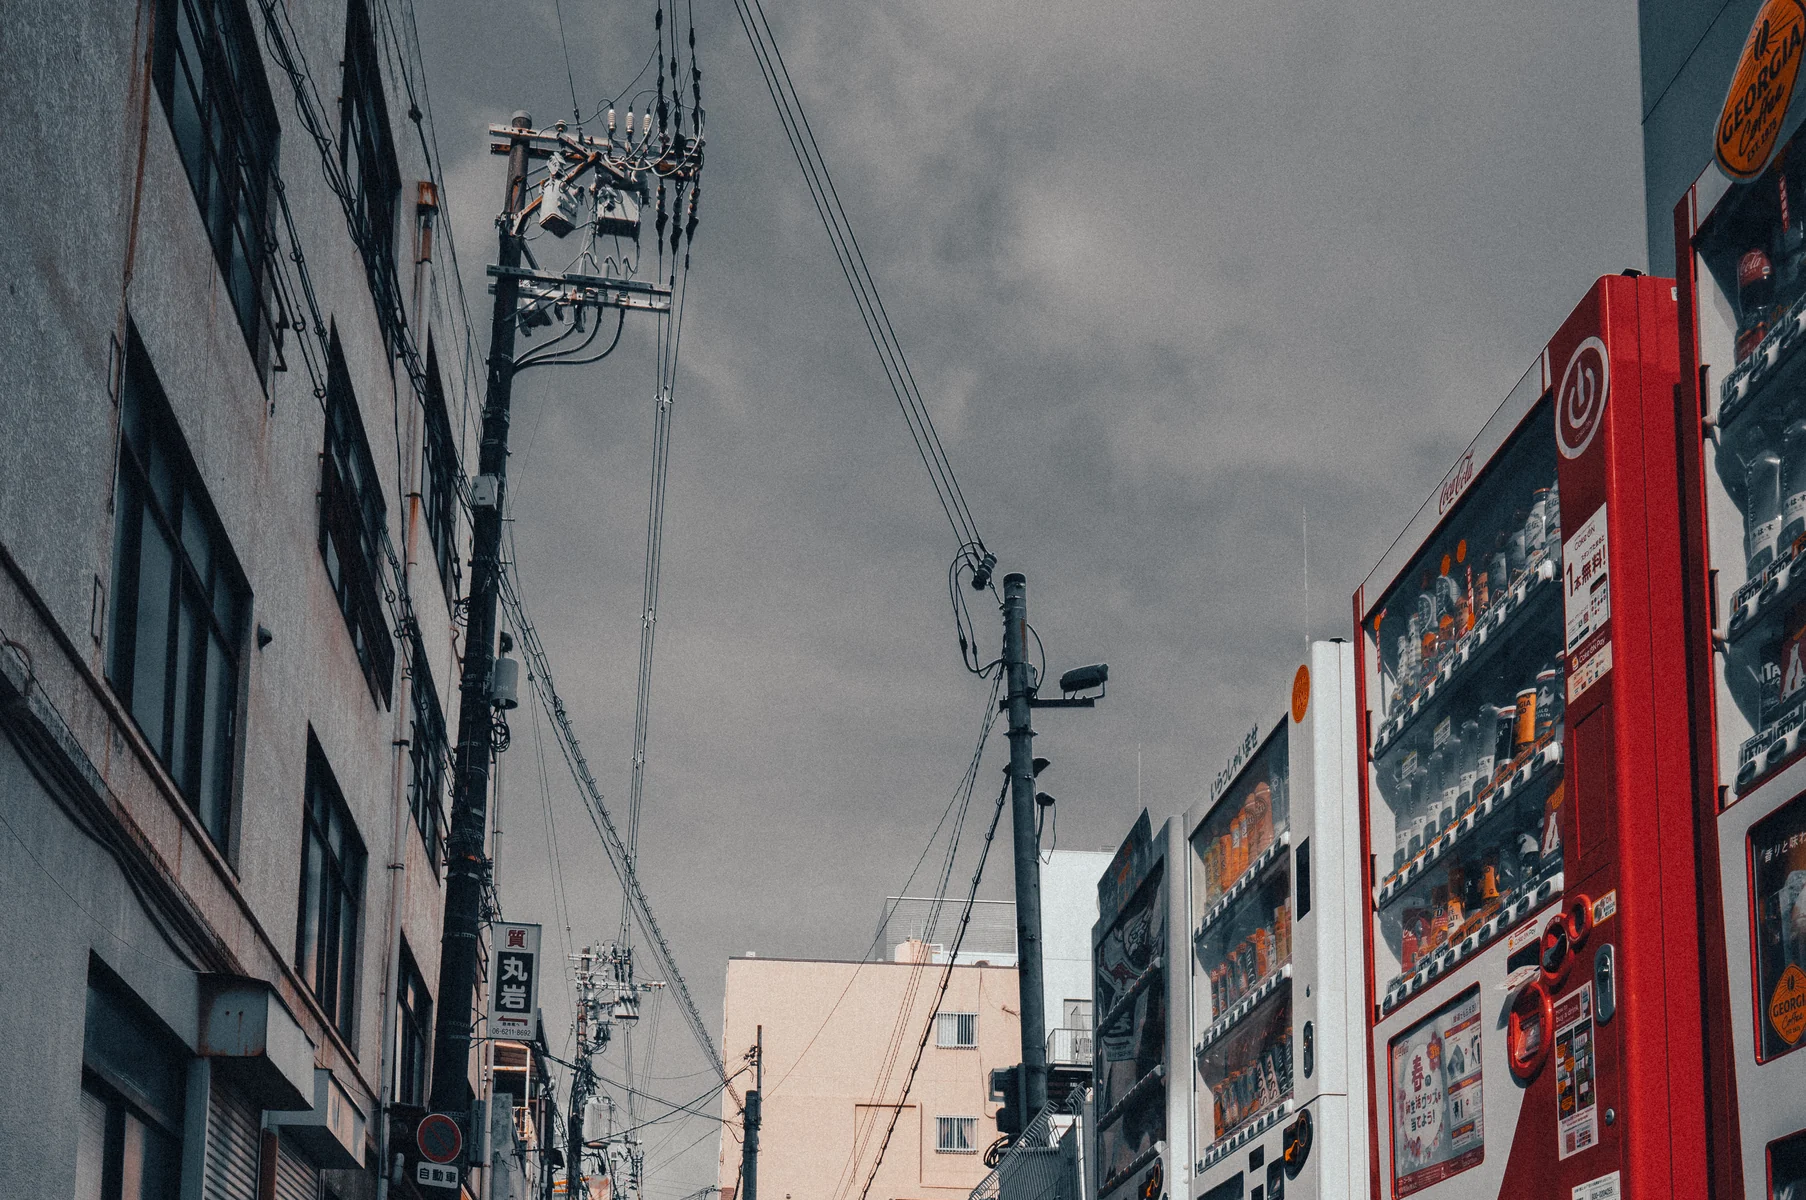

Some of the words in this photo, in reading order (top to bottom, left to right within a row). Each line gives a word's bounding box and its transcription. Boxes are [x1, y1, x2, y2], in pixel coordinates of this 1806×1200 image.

[1722, 22, 1802, 146] GEORGIA
[1738, 83, 1786, 158] Coffee
[1439, 446, 1475, 515] Coca-Cola
[1209, 722, 1259, 802] いらっしゃいませ
[507, 929, 526, 949] 質
[500, 956, 528, 1009] 丸岩
[1773, 993, 1806, 1018] GEORGI
[419, 1167, 457, 1184] 自動車
